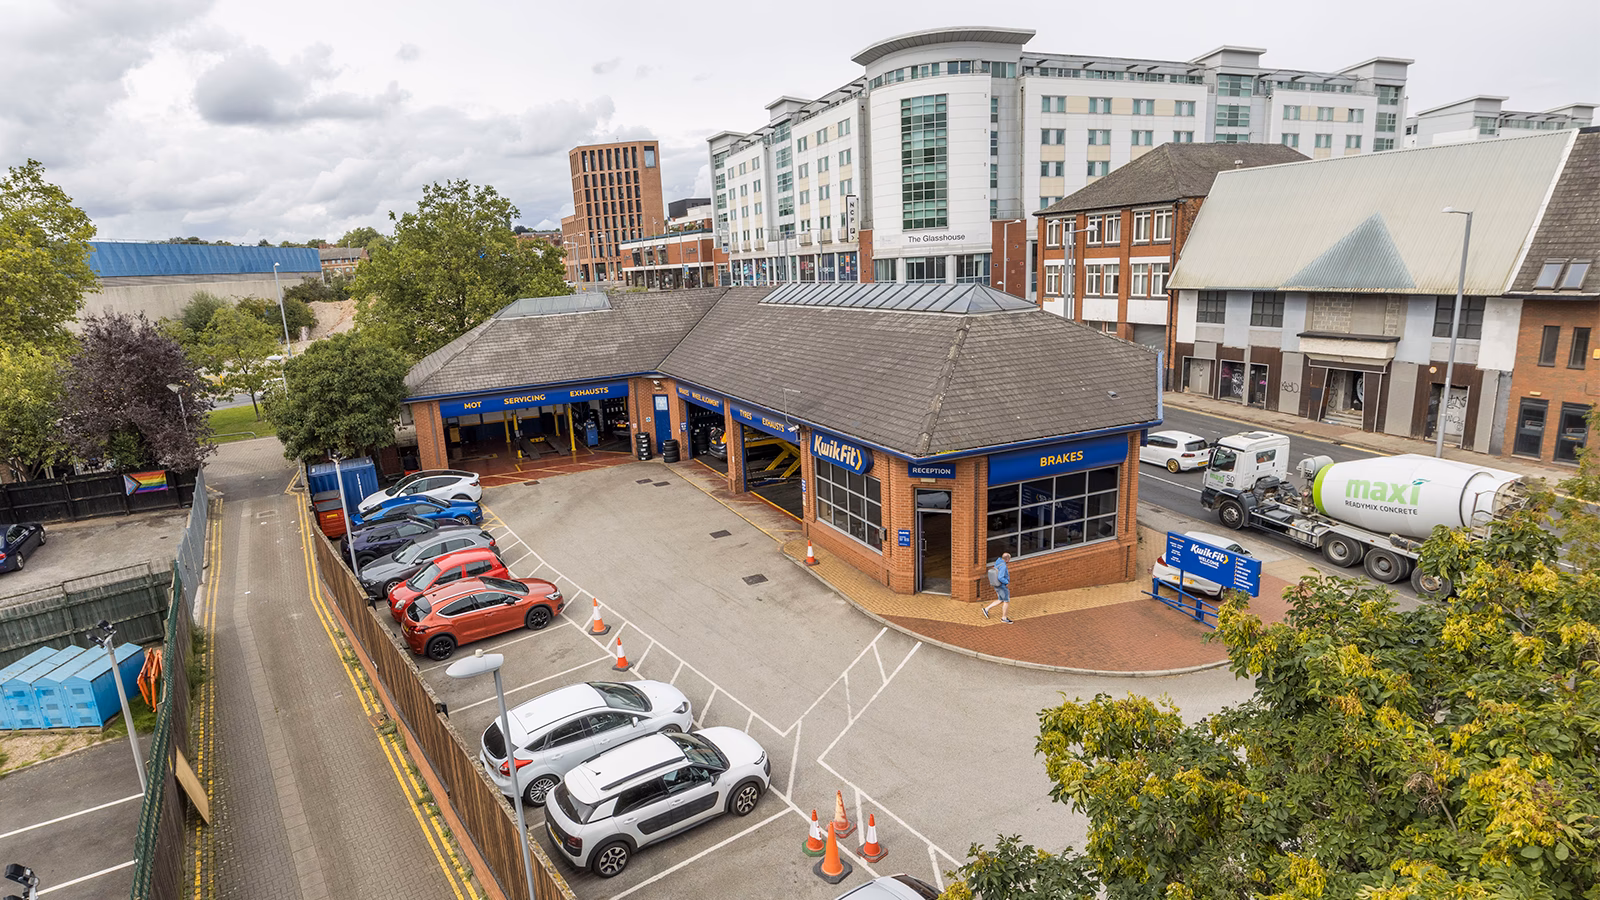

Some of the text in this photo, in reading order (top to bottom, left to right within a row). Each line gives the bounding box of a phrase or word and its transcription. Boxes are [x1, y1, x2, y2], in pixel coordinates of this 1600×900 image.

[922, 234, 966, 242] Glasshouse
[504, 394, 546, 405] SERVICING
[570, 387, 608, 398] EXHAUSTS
[740, 410, 784, 432] TYRES EXHAUSTS
[814, 434, 856, 467] KwikFit
[1040, 450, 1083, 466] BRAKES
[1210, 473, 1224, 482] maxi
[1346, 479, 1420, 506] maxi
[1345, 500, 1418, 515] READYMIX CONCRETE
[1190, 544, 1225, 563] KwikFit
[1198, 556, 1220, 567] WELCOME
